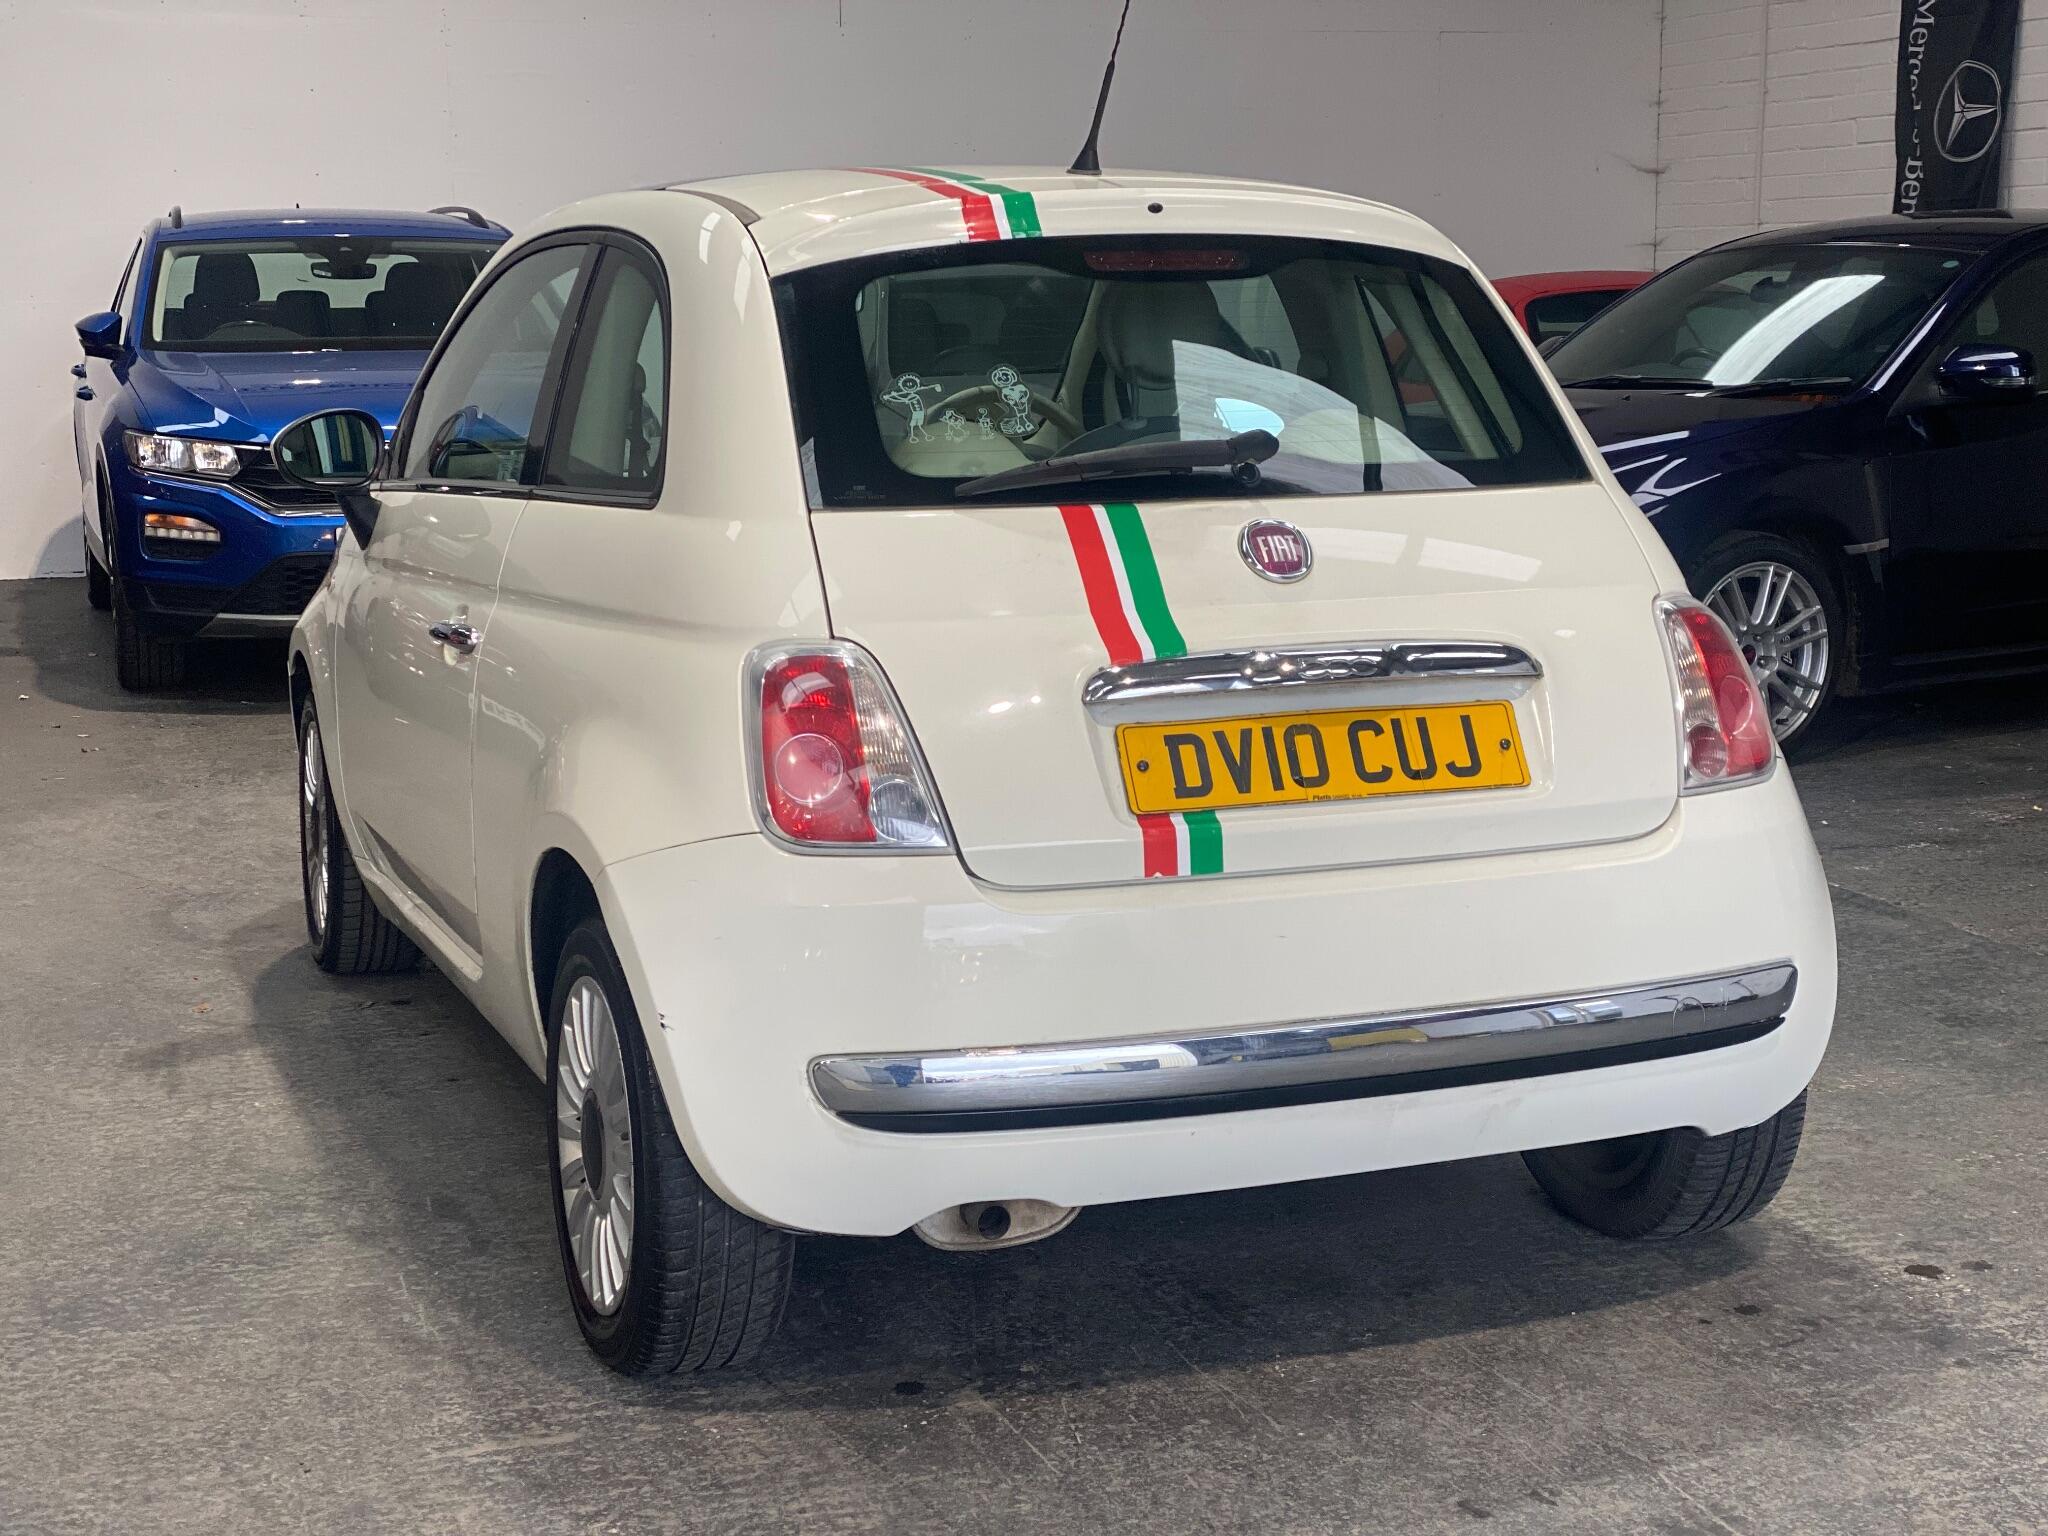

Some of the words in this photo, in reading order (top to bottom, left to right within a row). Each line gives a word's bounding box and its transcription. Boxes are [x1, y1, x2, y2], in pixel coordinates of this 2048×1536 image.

[1256, 535, 1298, 563] FIAT
[1163, 724, 1330, 800] DV10
[1347, 714, 1482, 784] CUJ
